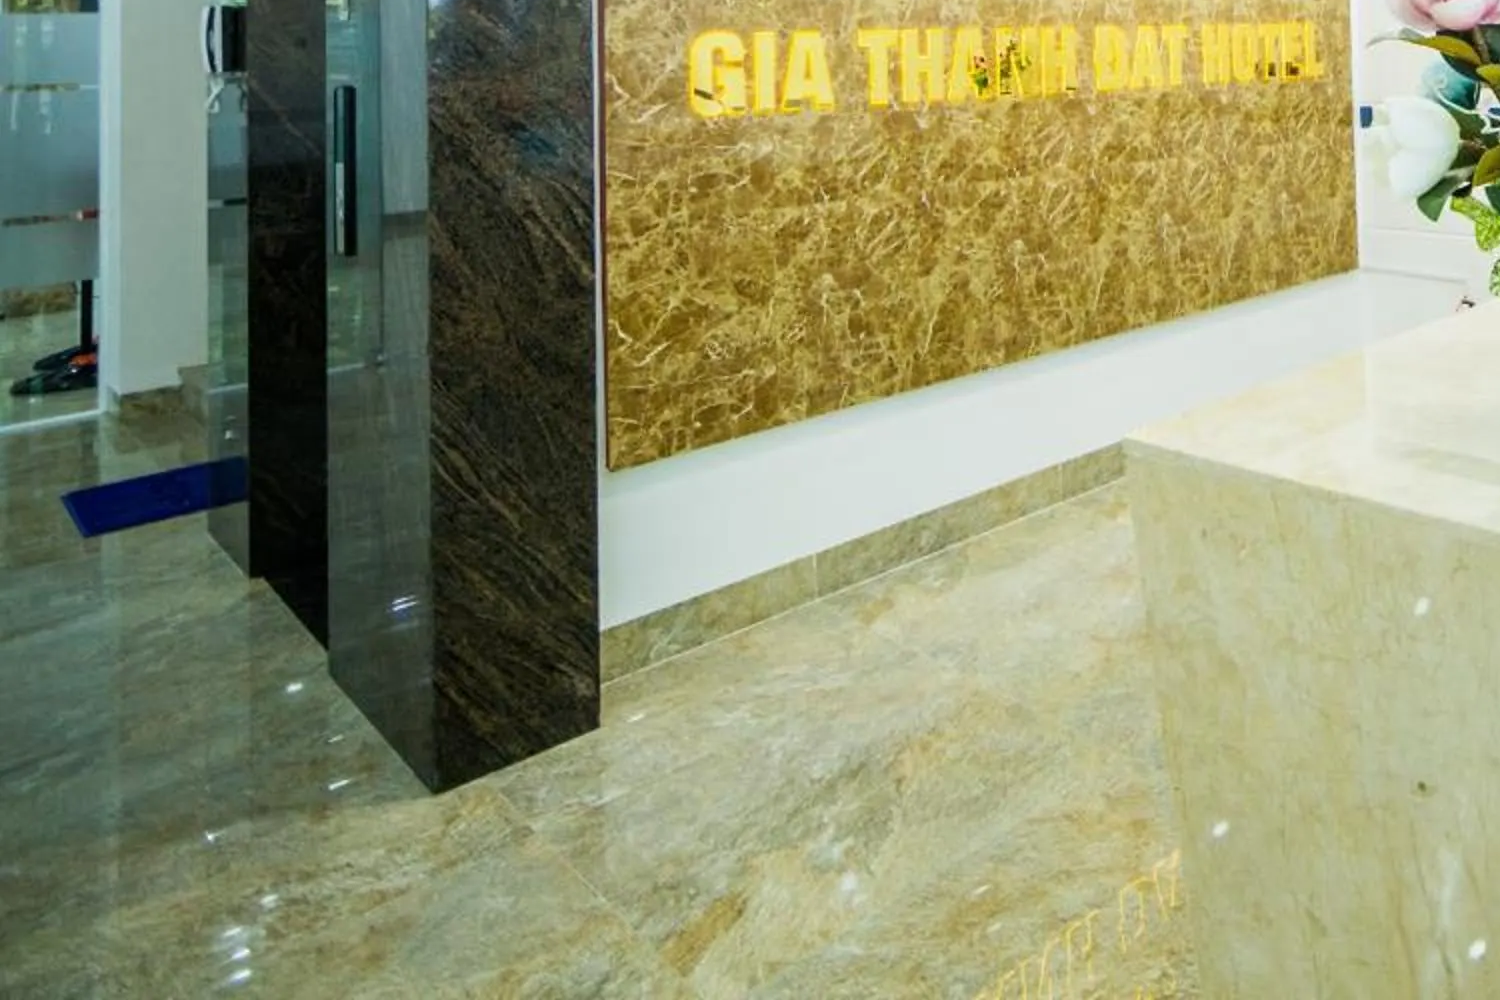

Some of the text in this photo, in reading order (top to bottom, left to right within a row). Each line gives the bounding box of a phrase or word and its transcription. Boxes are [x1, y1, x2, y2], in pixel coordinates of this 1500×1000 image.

[689, 28, 836, 117] GIA
[857, 25, 1078, 105] THANH
[1201, 21, 1326, 86] HOTEL
